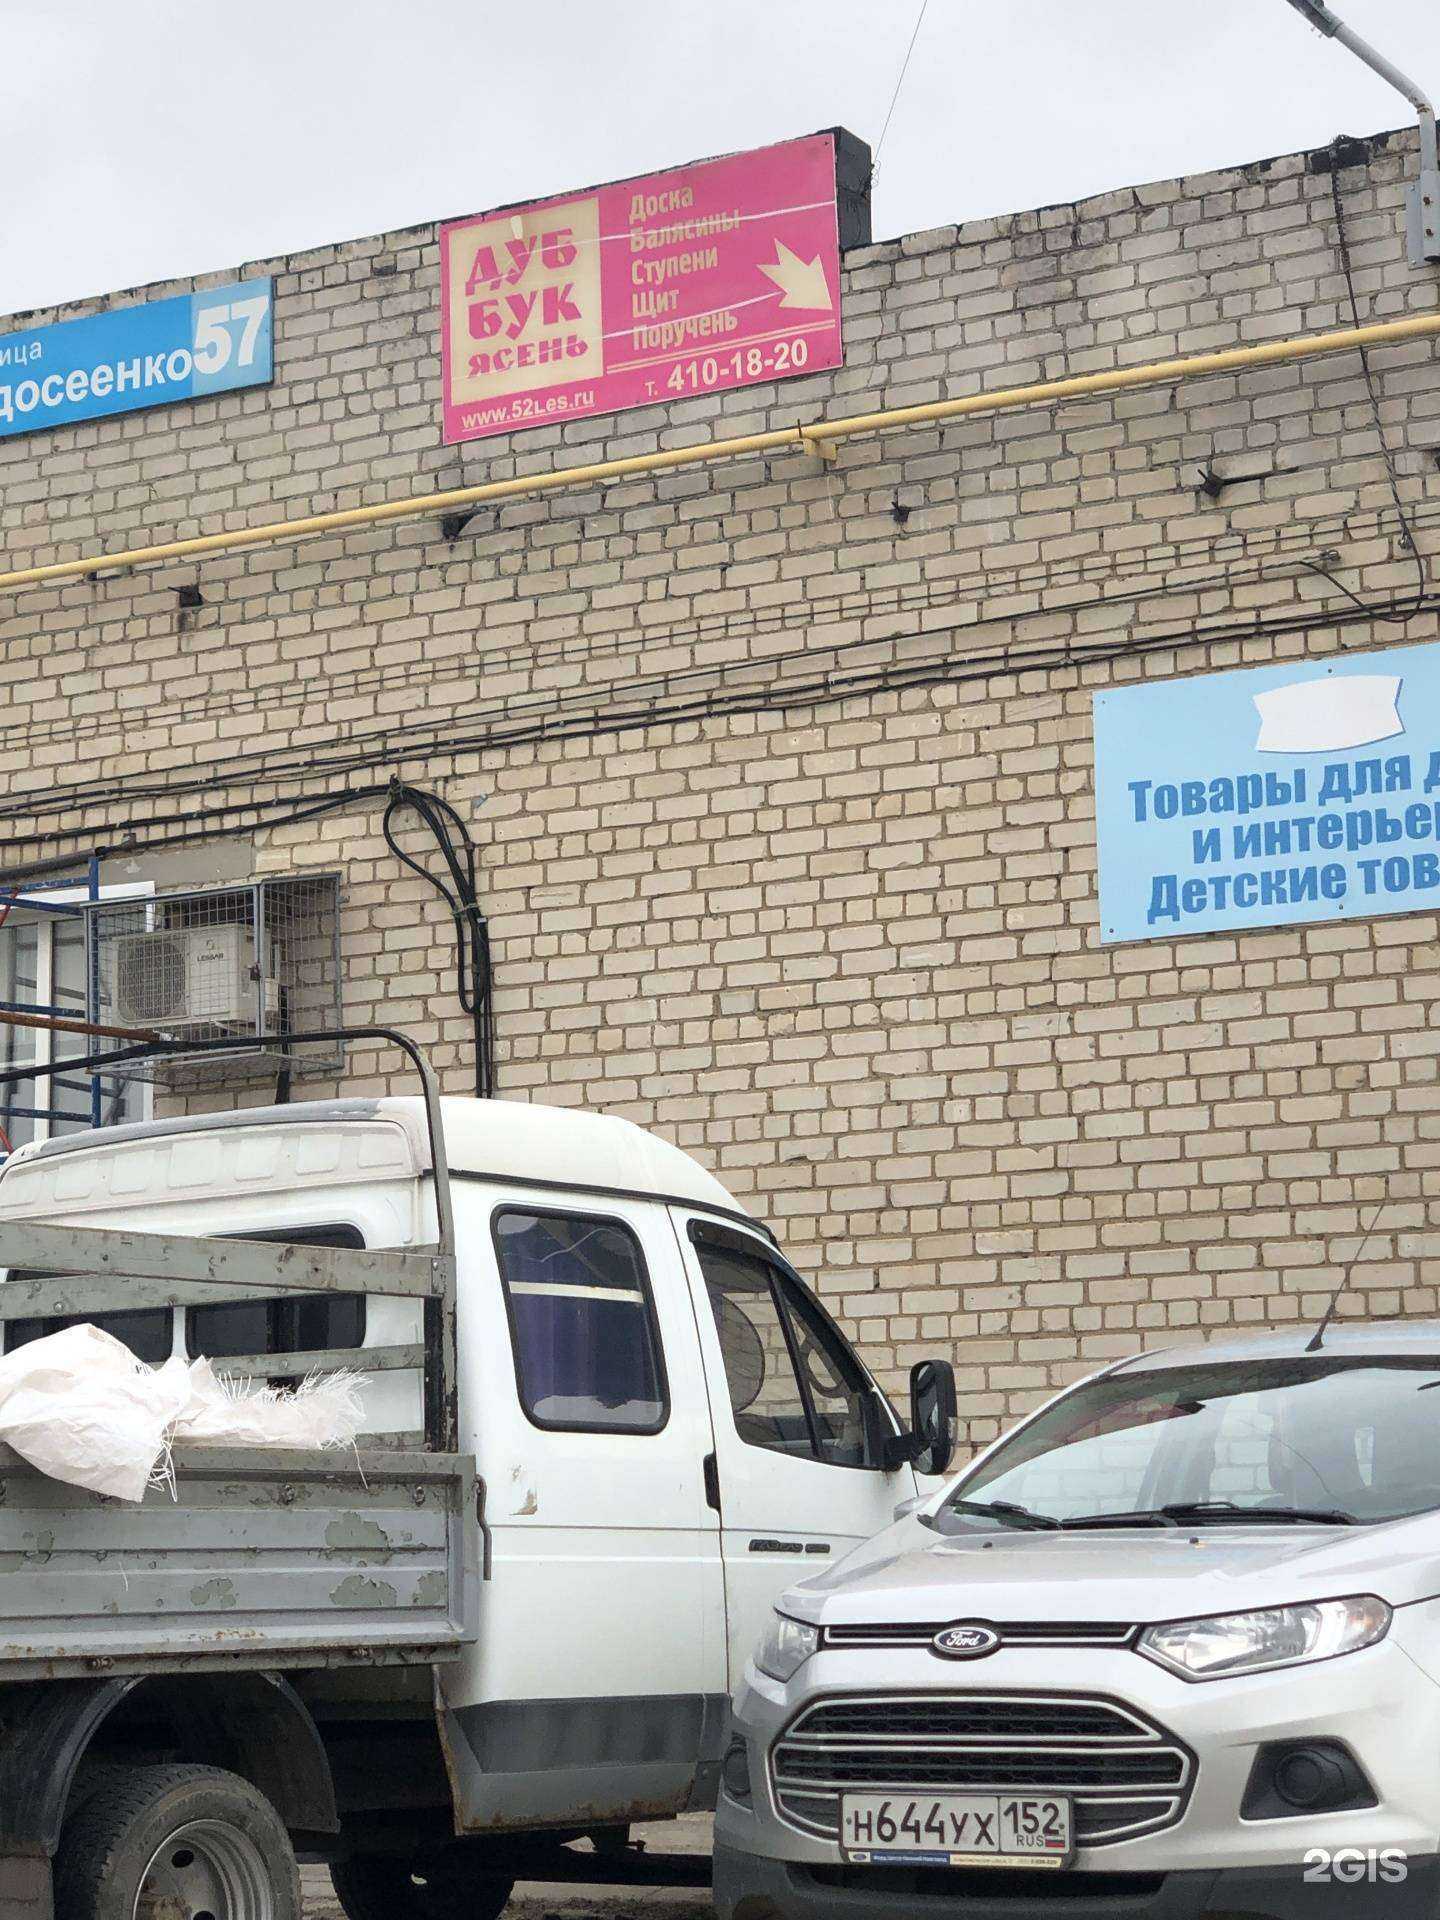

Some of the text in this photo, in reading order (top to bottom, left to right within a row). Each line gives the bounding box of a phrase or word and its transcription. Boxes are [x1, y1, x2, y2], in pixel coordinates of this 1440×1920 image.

[629, 186, 693, 224] Доска
[630, 209, 740, 252] Балясины
[465, 228, 577, 296] ДУБ
[631, 247, 718, 285] Ступени
[468, 282, 582, 340] БУК
[632, 289, 680, 319] Щит
[193, 295, 269, 374] 57
[633, 311, 738, 350] Поручень
[467, 335, 588, 378] ЯСЕНЬ
[667, 338, 808, 391] 410-18-20
[461, 389, 595, 429] www.52Les.ru
[1128, 768, 1306, 822] Товары
[1318, 755, 1412, 806] для
[1192, 802, 1440, 864] и интерье
[1147, 853, 1440, 924] Детские тов
[946, 1631, 981, 1646] Ford
[854, 1801, 1060, 1846] Н644УХ 152
[1016, 1834, 1044, 1847] RUS
